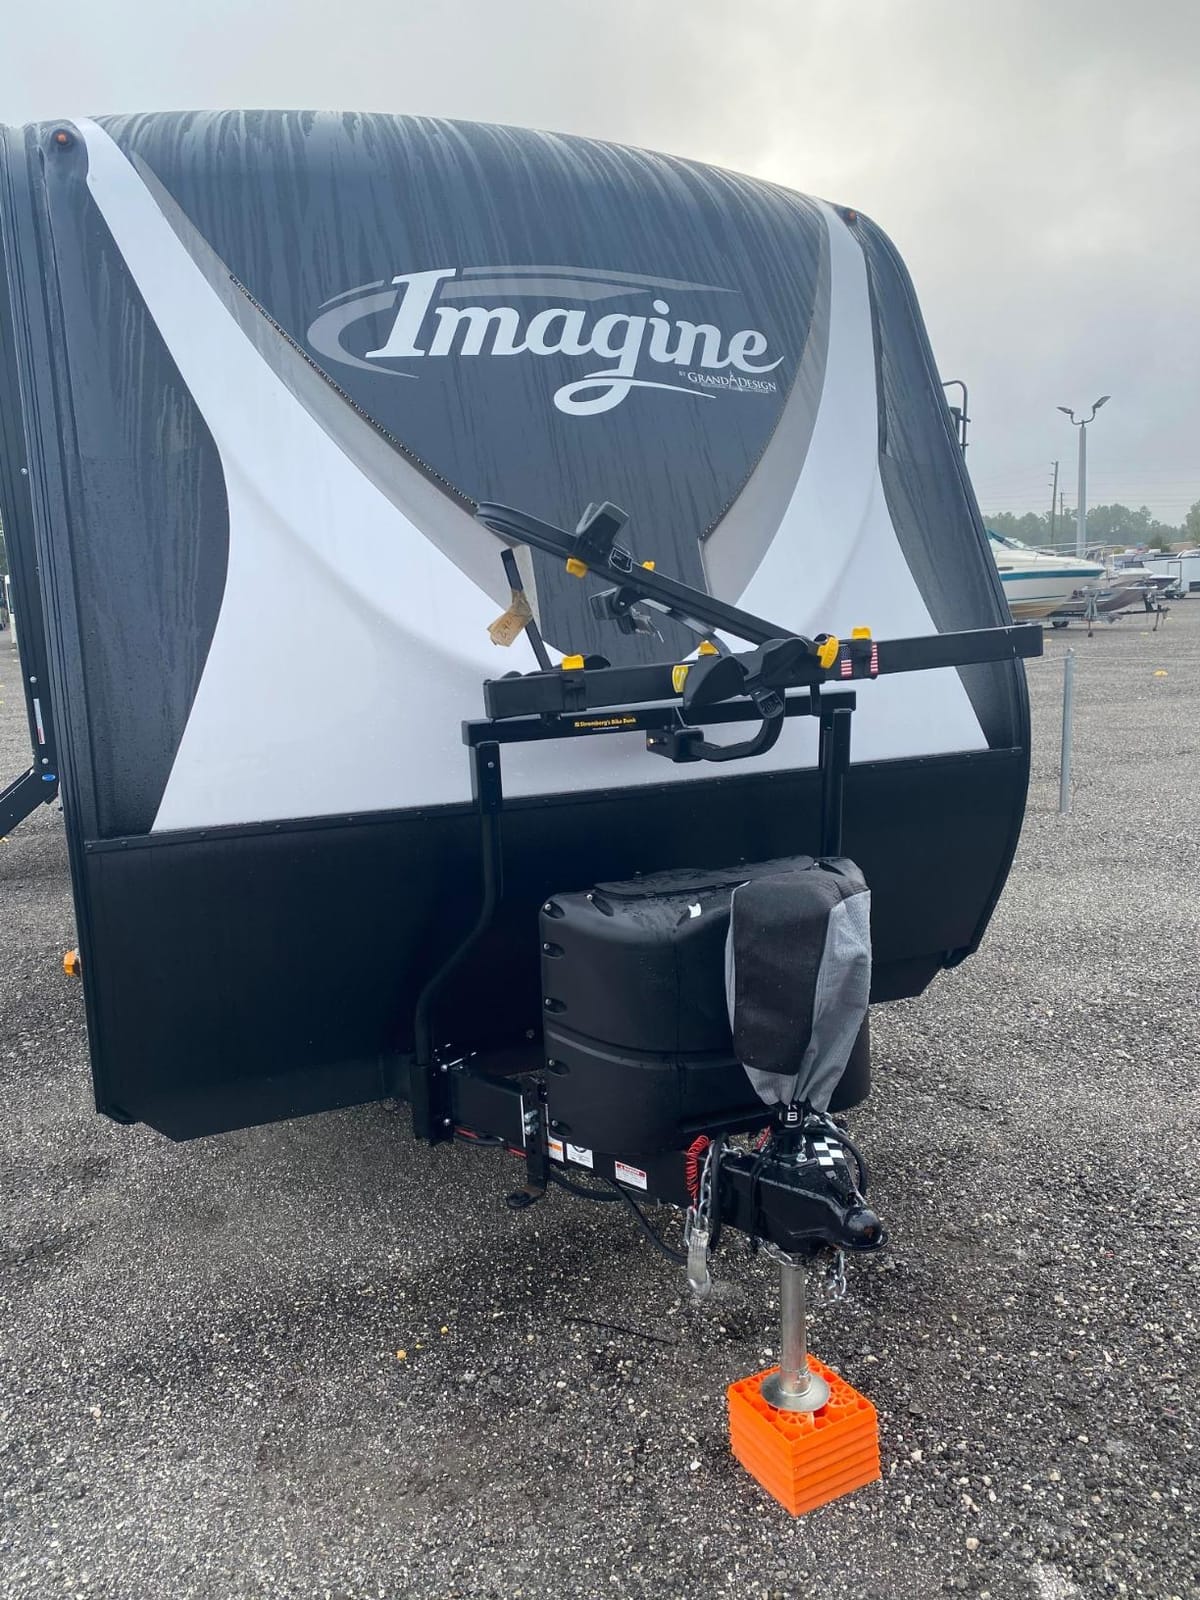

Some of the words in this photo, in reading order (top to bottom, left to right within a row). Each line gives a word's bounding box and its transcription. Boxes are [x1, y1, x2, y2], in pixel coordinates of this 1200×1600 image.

[365, 267, 785, 416] Imagine
[687, 372, 729, 385] GRAND
[739, 377, 776, 391] DESIGN
